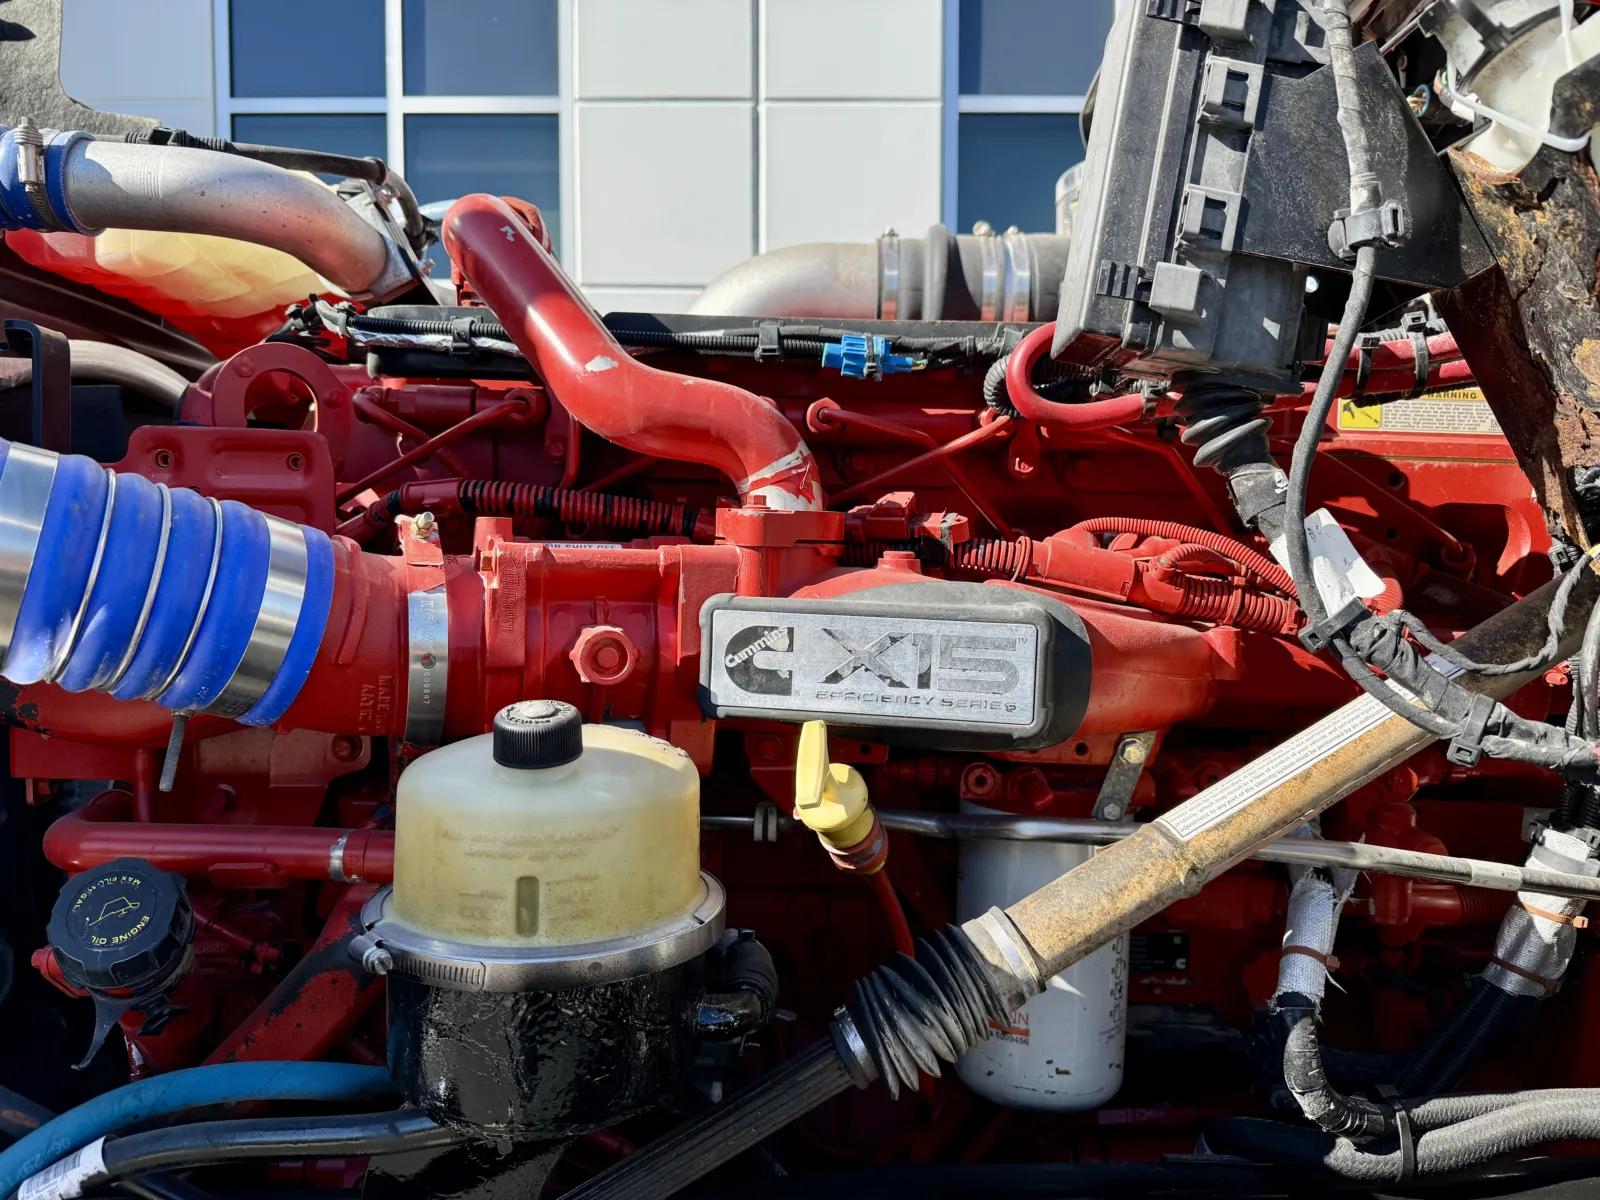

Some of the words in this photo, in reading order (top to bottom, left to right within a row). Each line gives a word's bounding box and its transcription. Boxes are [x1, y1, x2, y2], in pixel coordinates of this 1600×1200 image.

[724, 626, 788, 668] Cummins
[816, 628, 1020, 695] X15
[815, 690, 935, 706] EFFICIENCY
[941, 697, 1018, 713] SERIES
[99, 876, 118, 886] FILL
[120, 875, 142, 886] MAX
[72, 893, 88, 911] GAL
[111, 915, 150, 944] ENGINE
[89, 935, 107, 945] OIL
